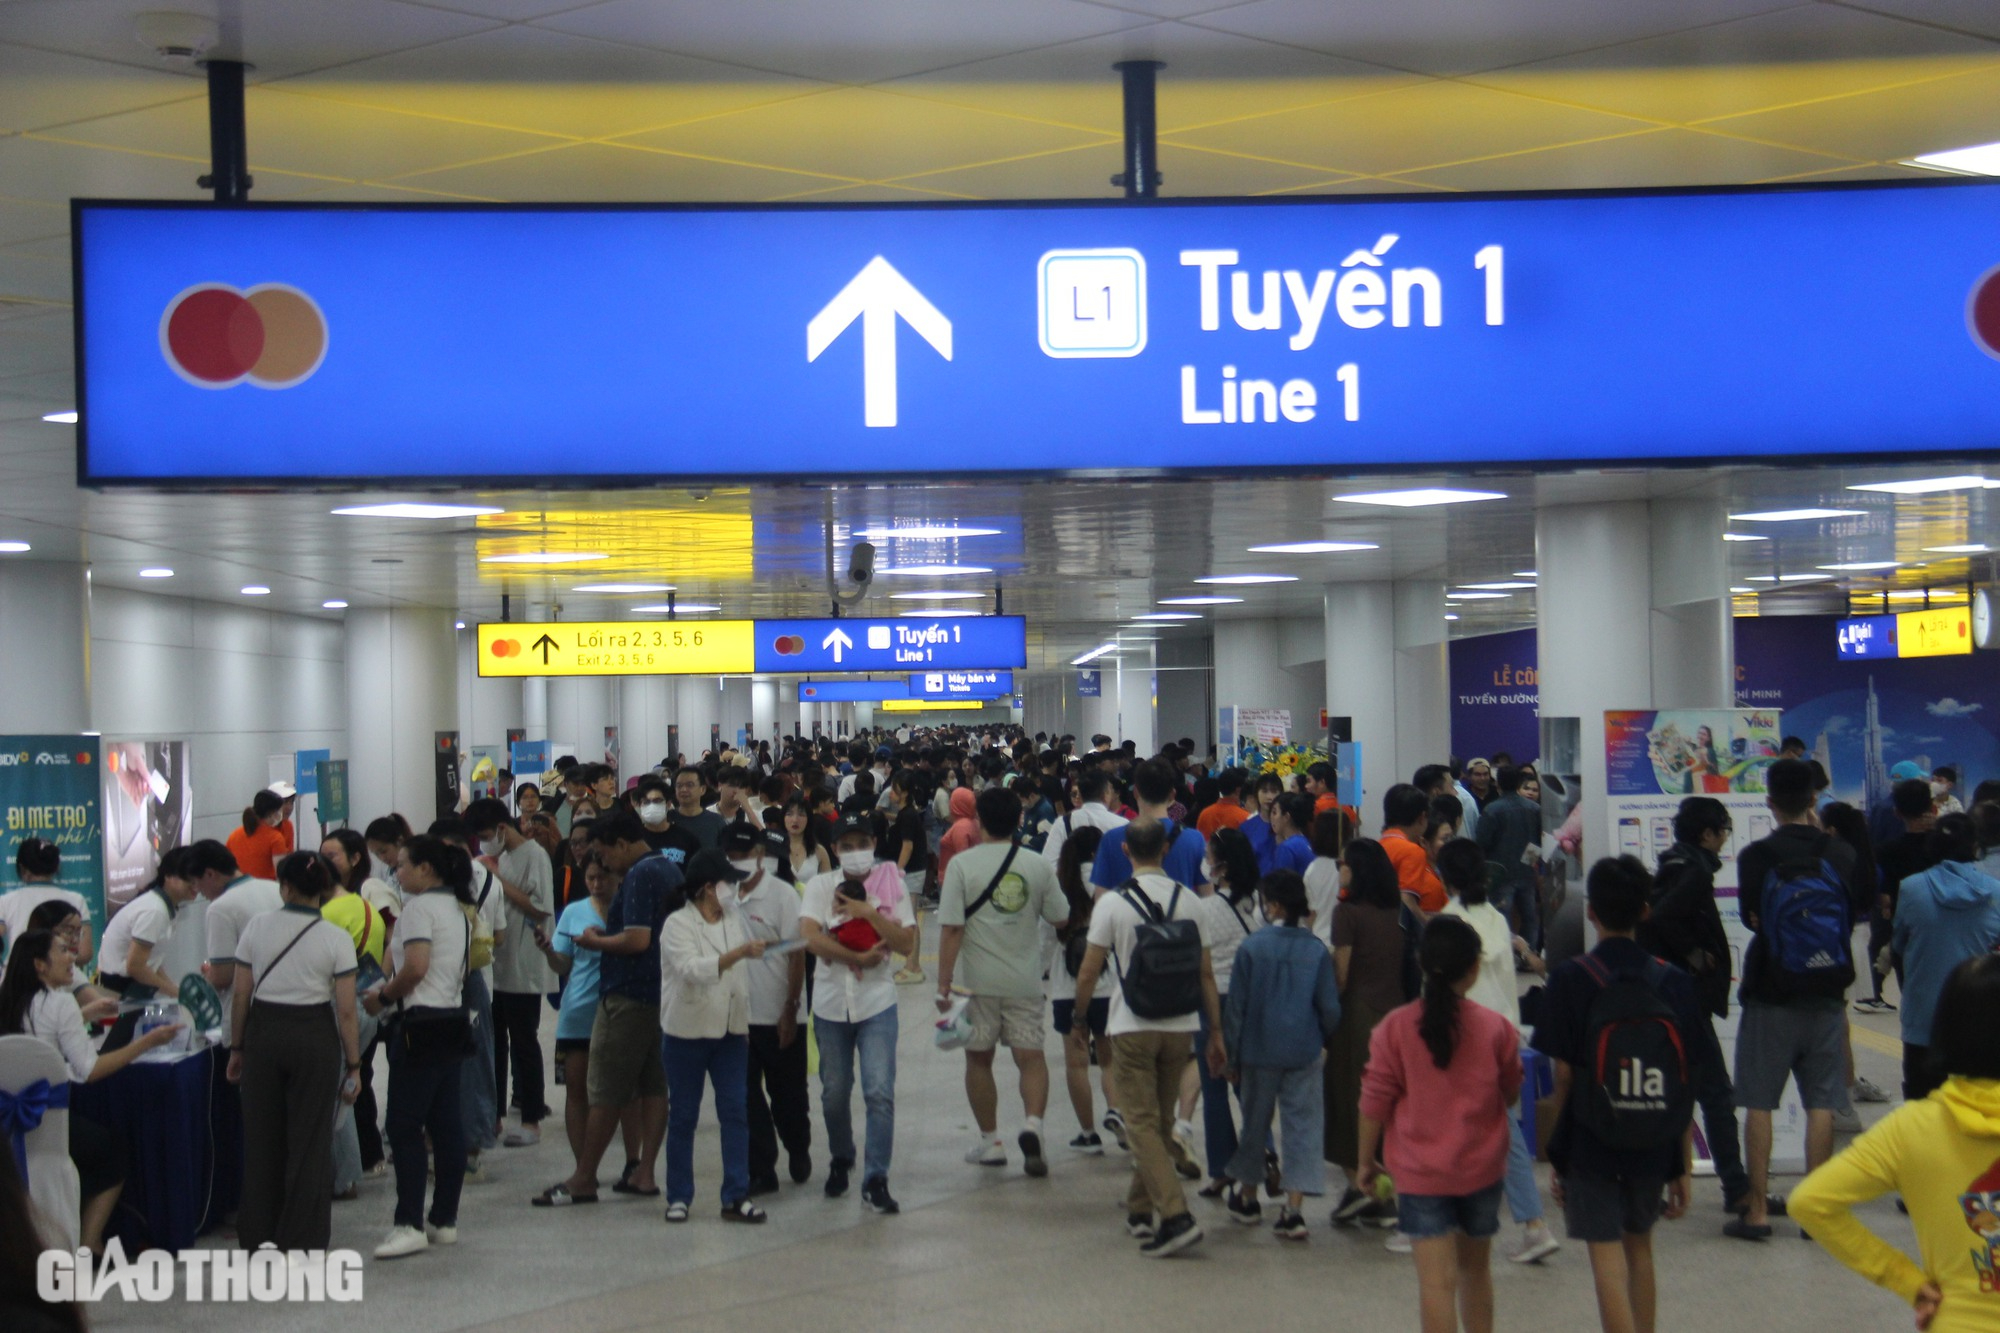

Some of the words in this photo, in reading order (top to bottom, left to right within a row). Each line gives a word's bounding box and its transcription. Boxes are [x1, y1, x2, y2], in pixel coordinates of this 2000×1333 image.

[1072, 285, 1112, 321] L1
[1180, 233, 1443, 351] Tuyến
[1474, 244, 1505, 326] 1
[1181, 364, 1318, 424] Line
[1336, 362, 1360, 422] 1
[577, 630, 603, 648] Lối
[609, 634, 627, 647] ra
[694, 630, 703, 646] 6
[895, 624, 949, 648] Tuyến
[953, 625, 961, 643] 1
[577, 654, 600, 666] Exit
[647, 653, 655, 665] 6
[895, 649, 924, 662] Line
[927, 648, 933, 662] 1
[1493, 664, 1512, 686] LỄ
[1459, 692, 1498, 705] TUYẾN
[1752, 689, 1781, 699] MINH
[6, 806, 25, 830] ĐI
[28, 805, 87, 829] METRO
[1619, 1056, 1664, 1097] ila
